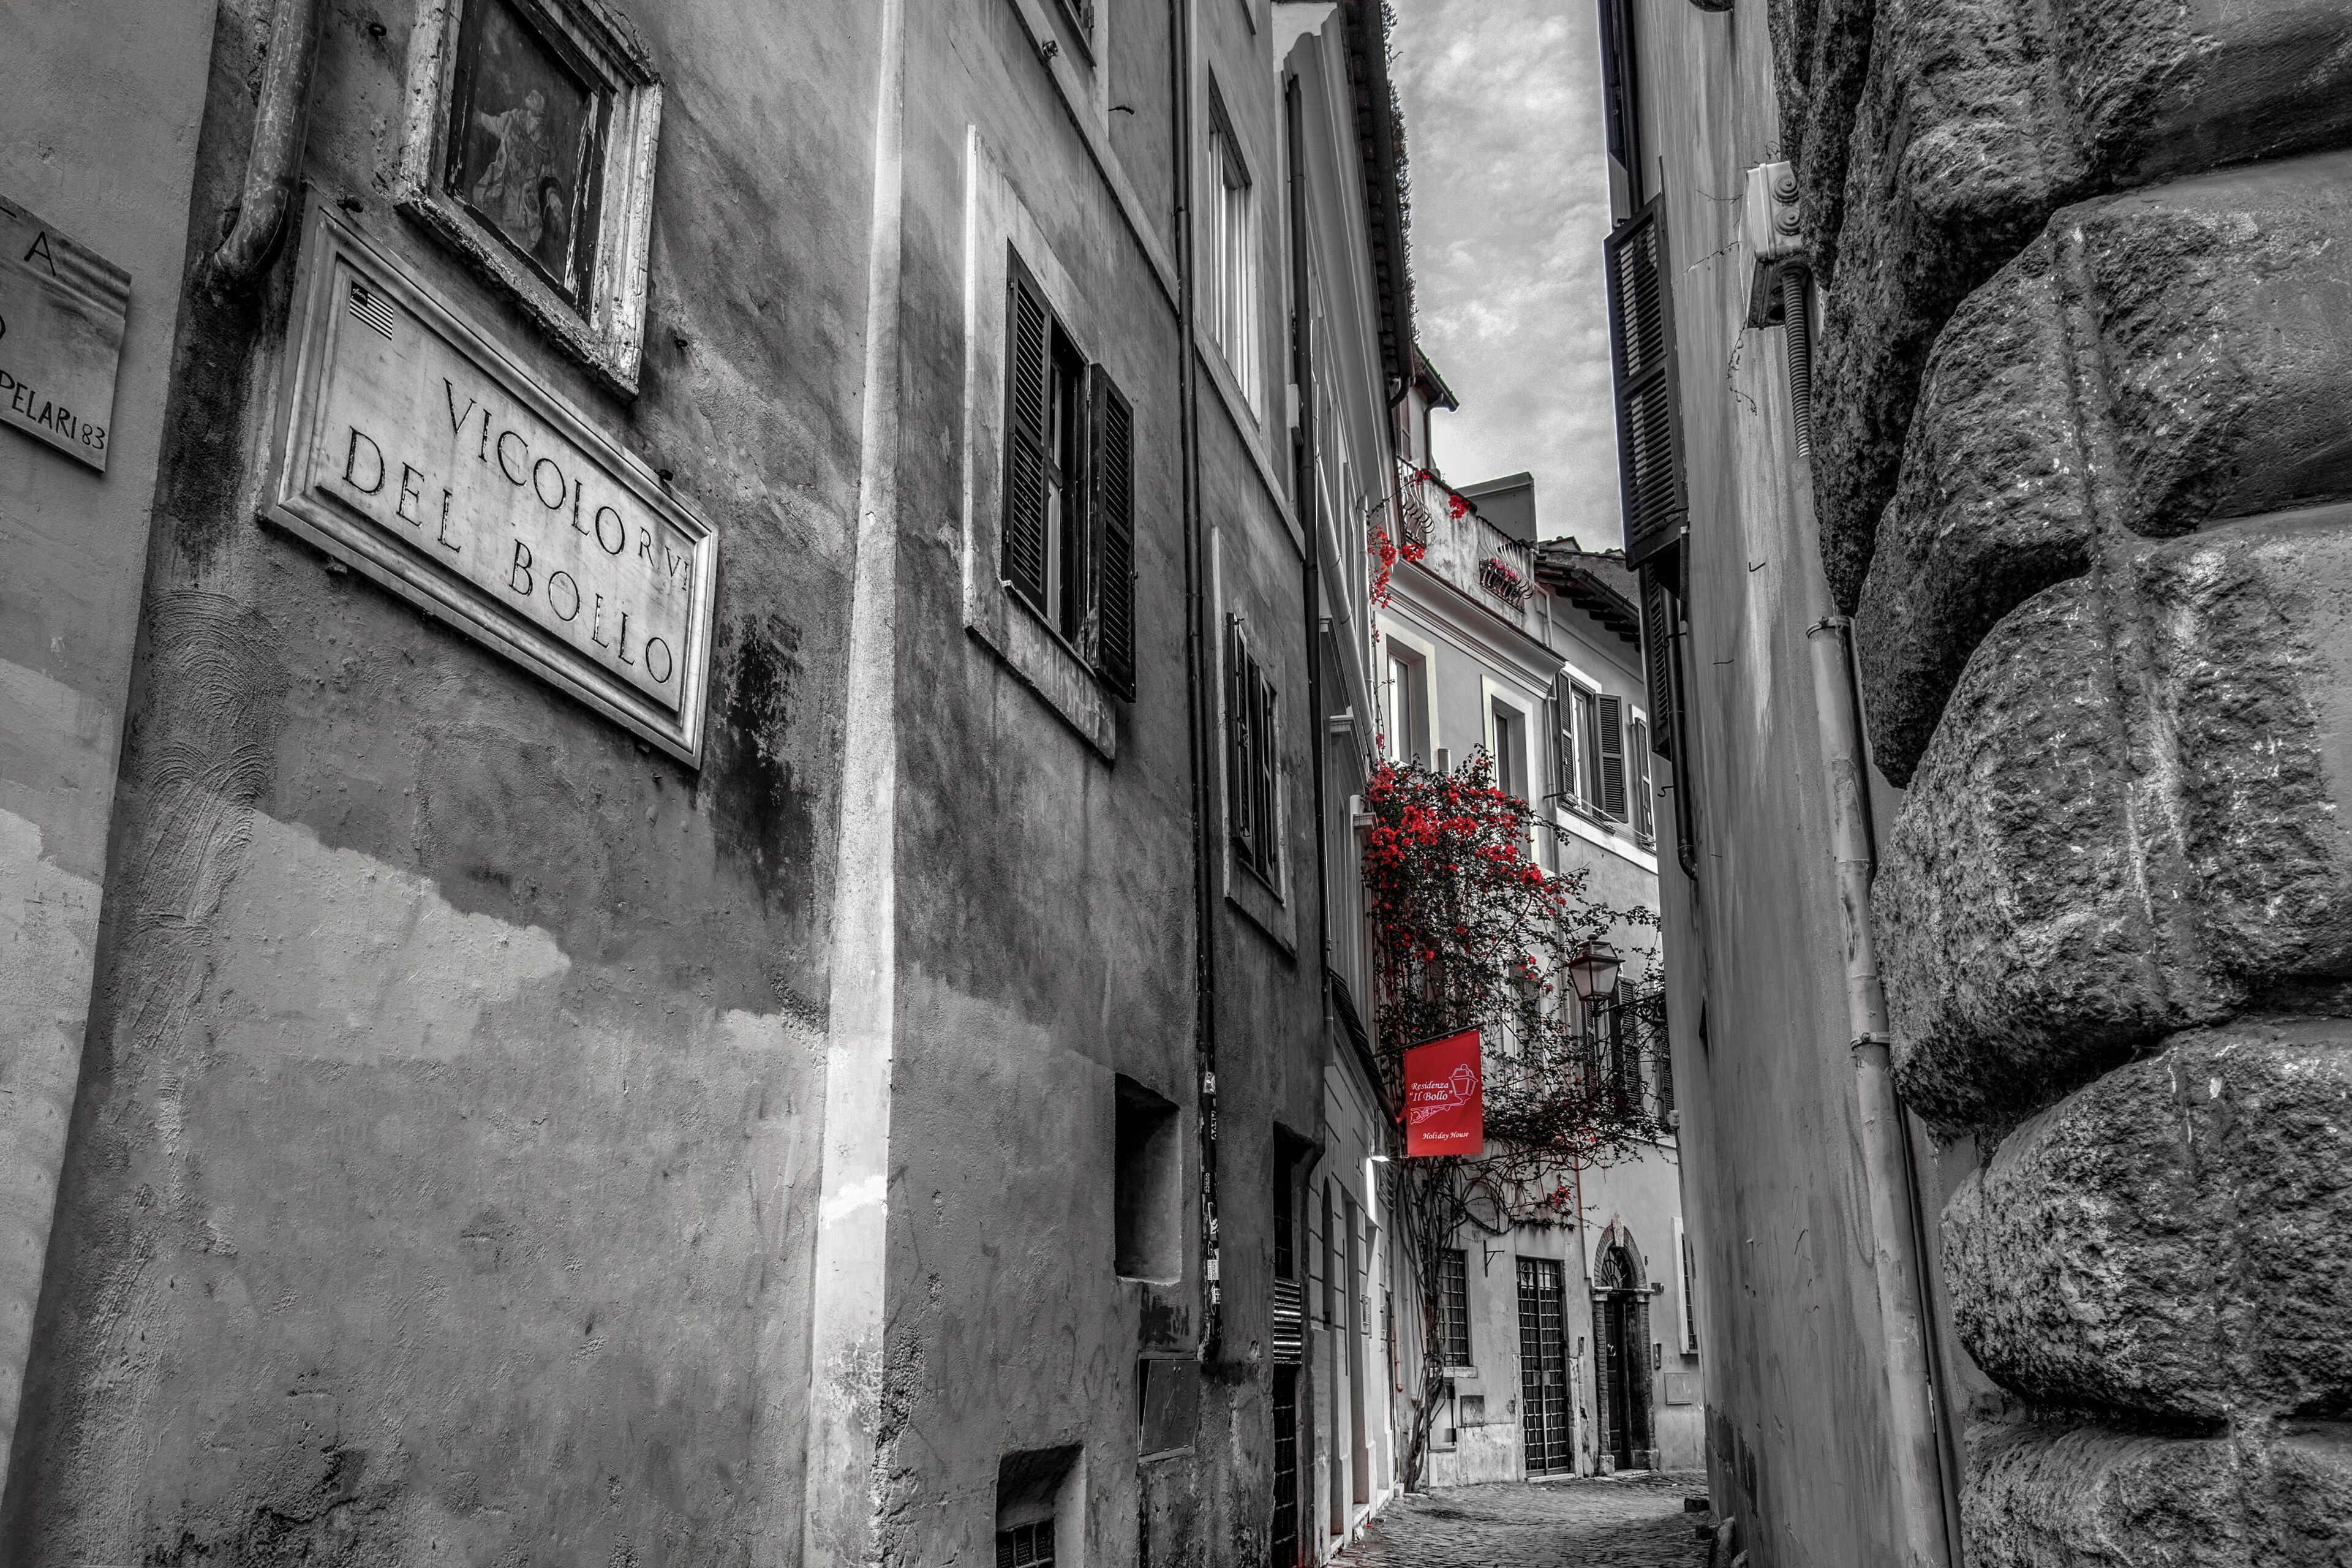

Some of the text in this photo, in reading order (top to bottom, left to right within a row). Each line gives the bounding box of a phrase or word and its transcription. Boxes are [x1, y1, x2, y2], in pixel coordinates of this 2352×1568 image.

[82, 423, 105, 450] 83
[443, 377, 625, 556] VICOLO
[342, 425, 673, 684] DEL BOLLO
[1411, 1080, 1449, 1090] Residenza
[1422, 1132, 1449, 1140] Holiday
[1645, 1255, 1648, 1265] 8
